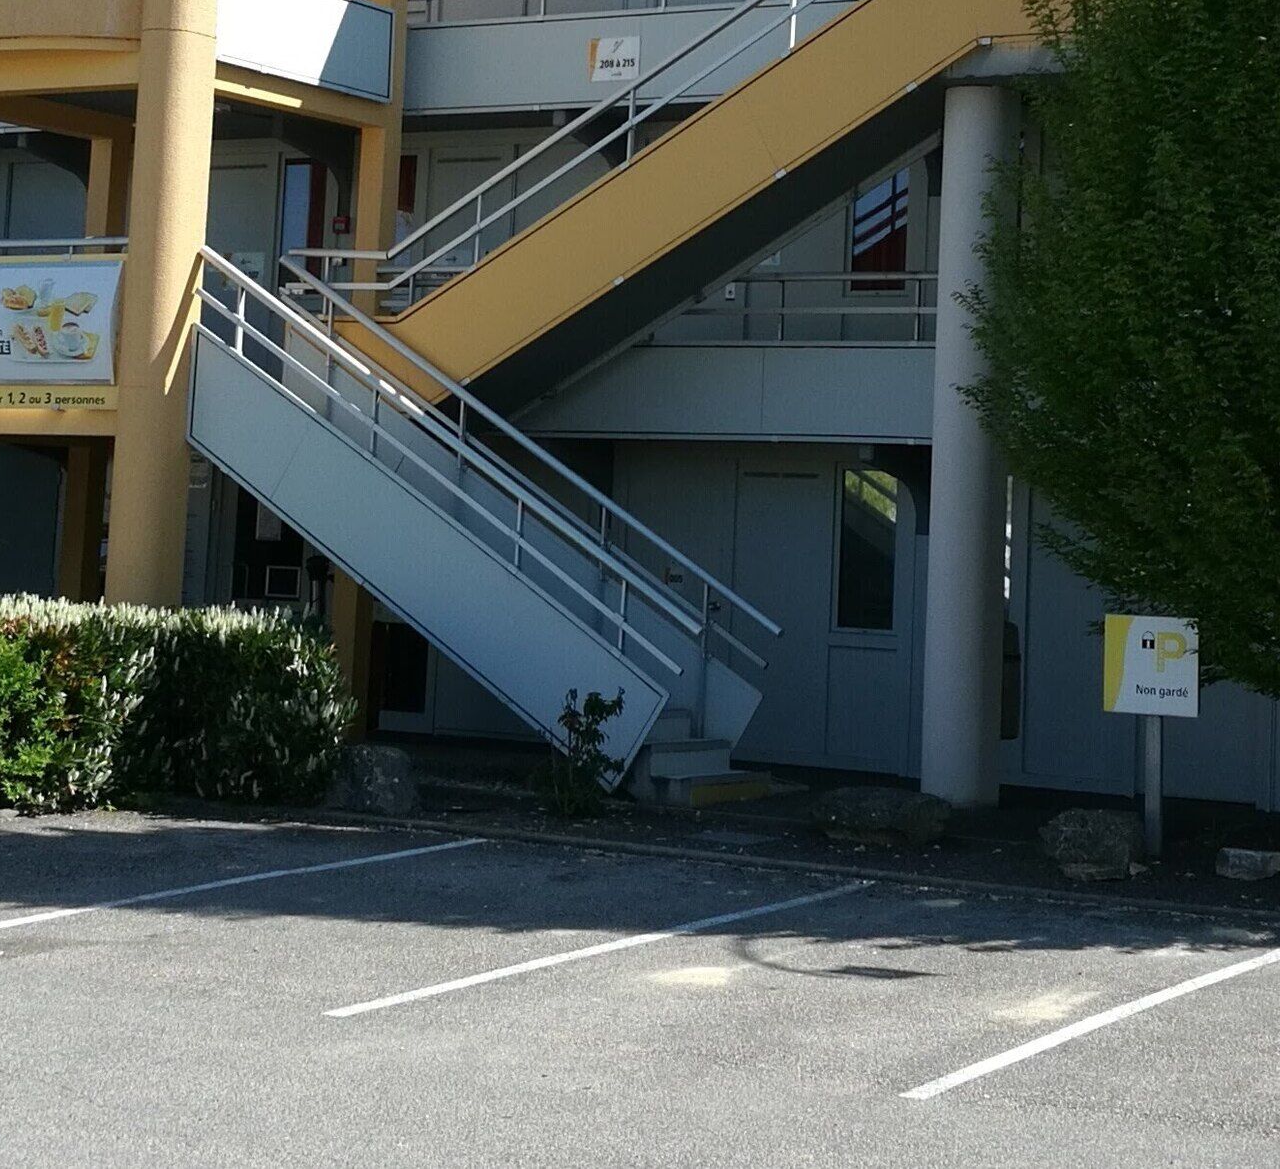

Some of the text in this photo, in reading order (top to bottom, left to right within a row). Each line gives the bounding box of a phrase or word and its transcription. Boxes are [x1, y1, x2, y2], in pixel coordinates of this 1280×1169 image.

[622, 58, 635, 68] 215
[7, 392, 16, 406] 1,
[18, 392, 26, 404] 2
[28, 395, 42, 404] ou
[43, 392, 52, 404] 3
[54, 395, 106, 406] personnes
[1135, 684, 1189, 698] Non gardé
